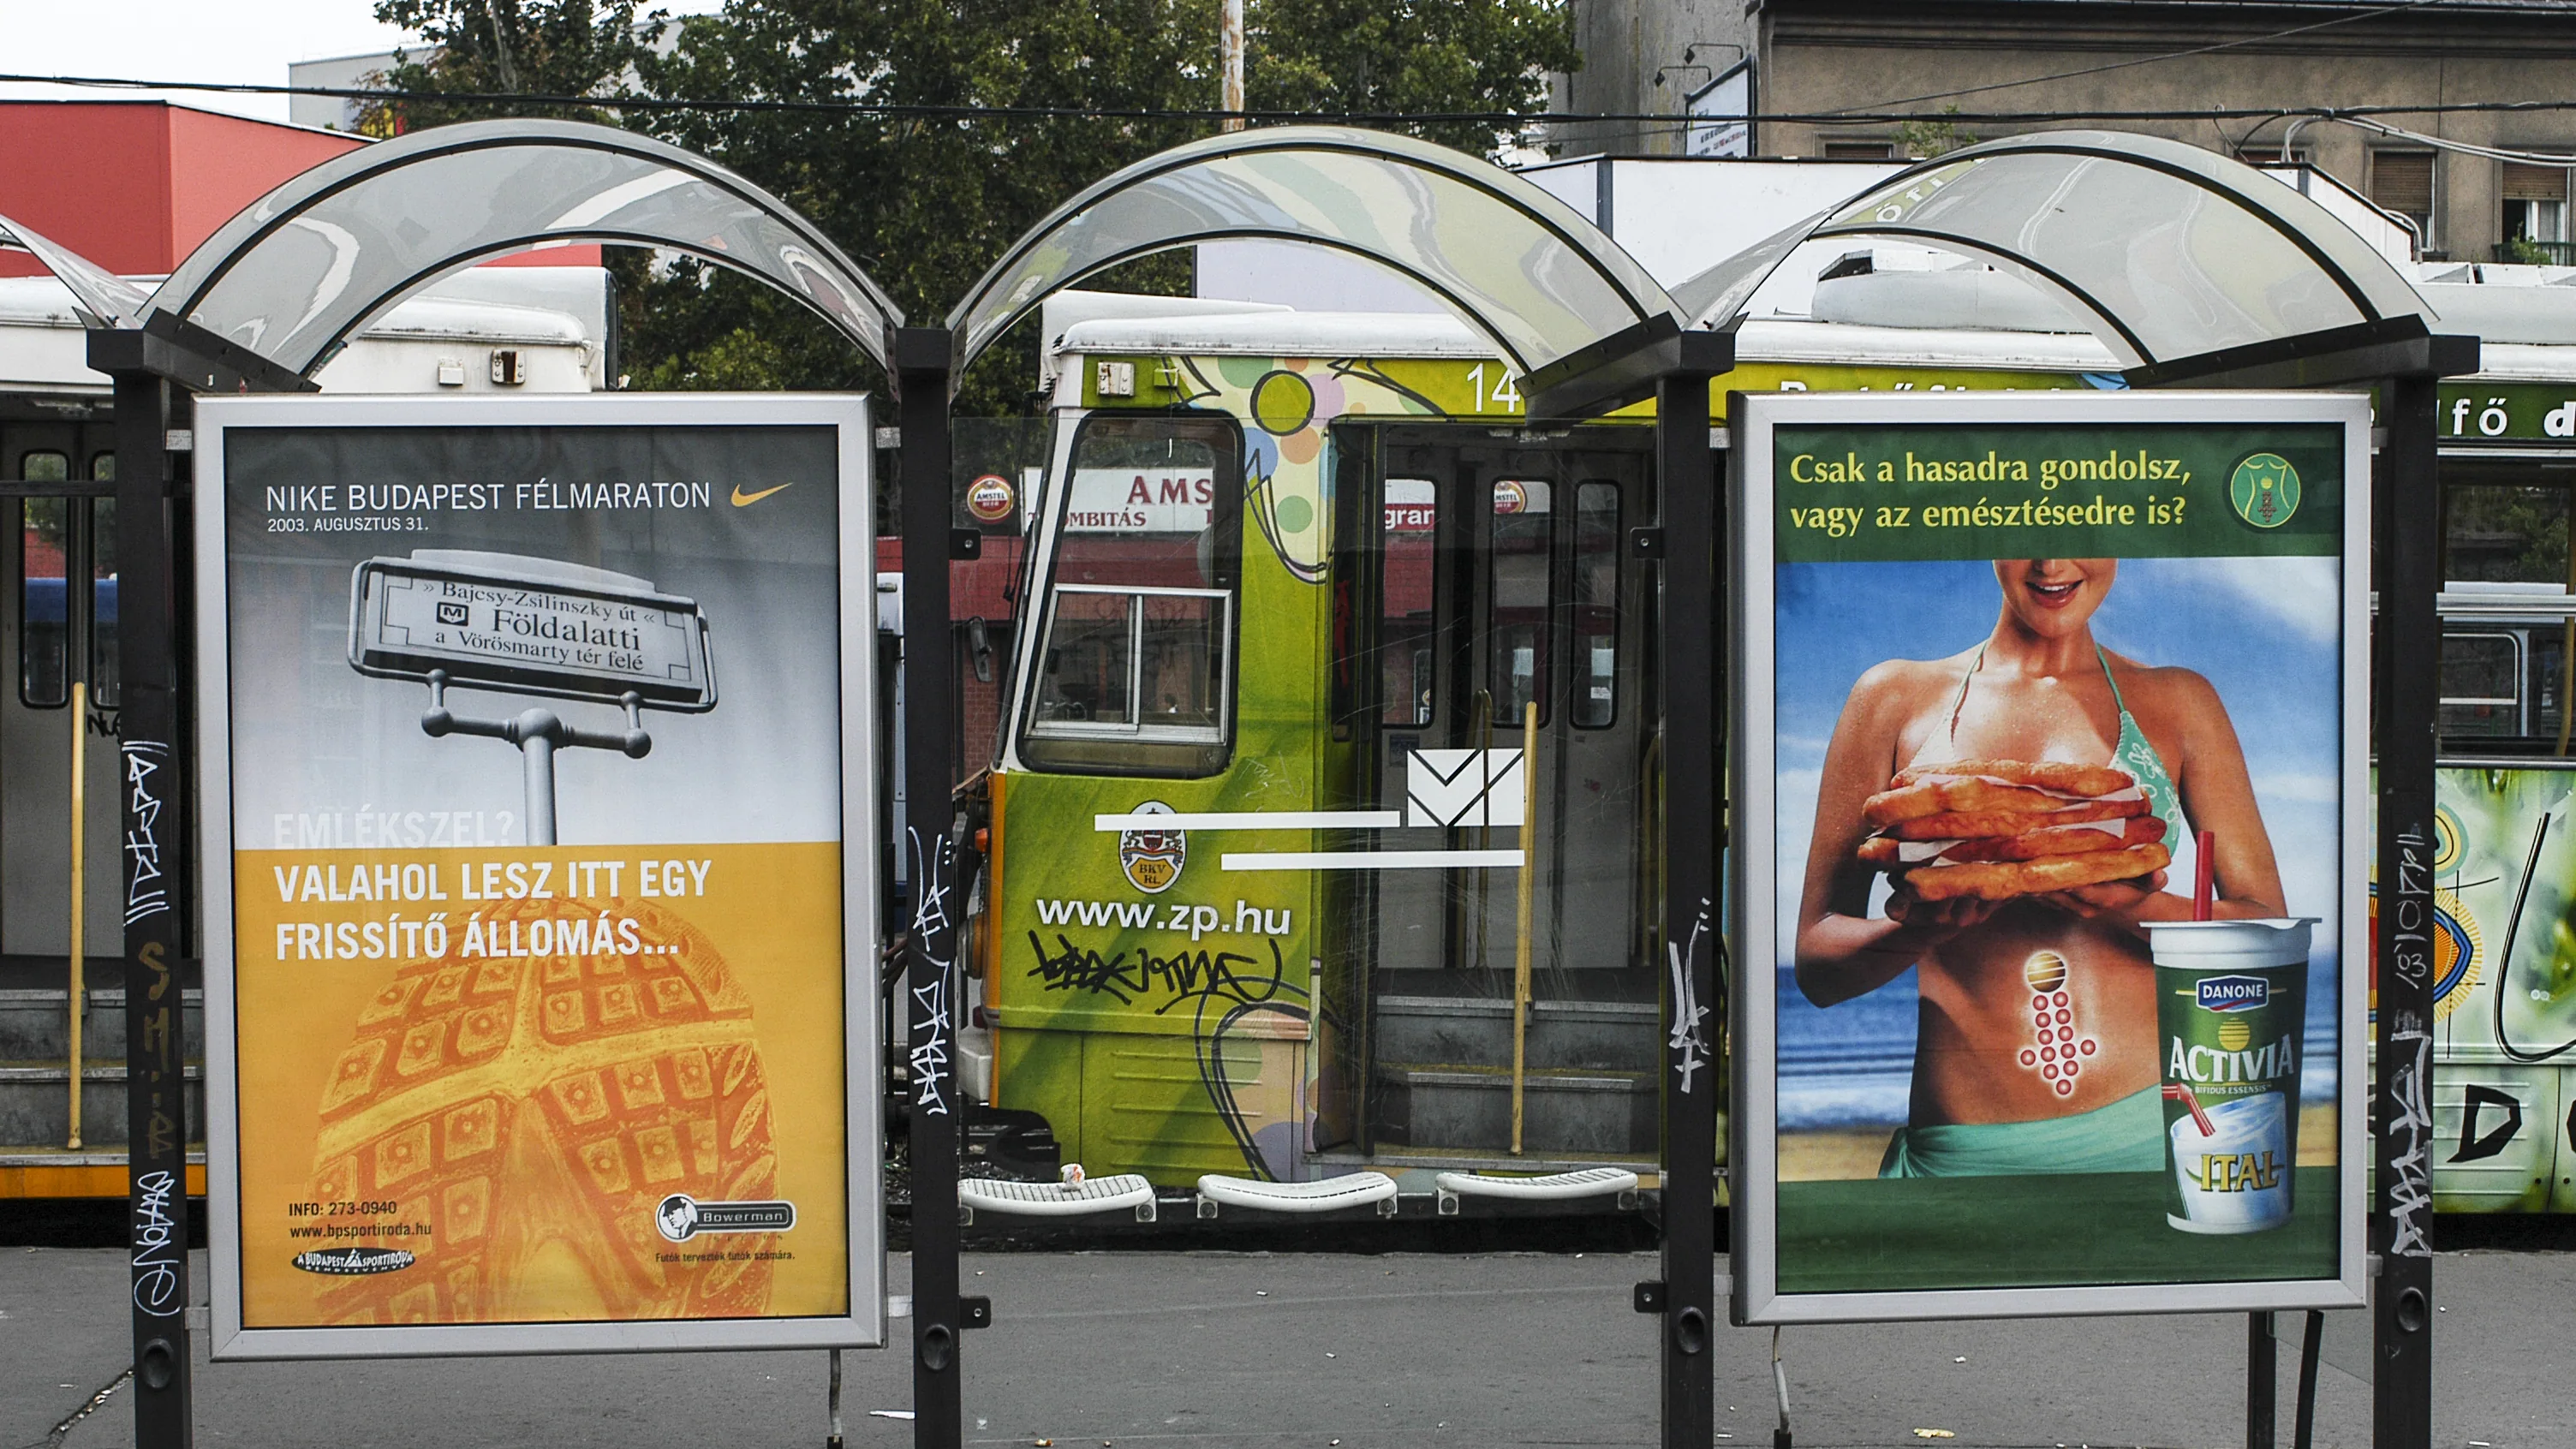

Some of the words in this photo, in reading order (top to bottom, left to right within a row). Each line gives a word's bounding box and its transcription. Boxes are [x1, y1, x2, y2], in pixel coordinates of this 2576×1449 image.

[1467, 362, 1521, 413] 14
[2436, 397, 2508, 436] fő
[1127, 474, 1213, 506] AMS
[1790, 451, 1866, 484] Csak
[1876, 463, 1895, 481] a
[1905, 450, 2030, 482] hasadra
[2040, 449, 2192, 492] gondolsz,
[266, 485, 337, 512] NIKE
[348, 483, 504, 512] BUDAPEST
[516, 476, 711, 510] FÉLMARATON
[267, 517, 309, 534] 2003.
[313, 516, 402, 532] AUGUSZTUS
[405, 516, 429, 531] 31.
[1790, 506, 1864, 539] vagy
[1875, 507, 1911, 528] az
[1922, 494, 2136, 529] emésztésedre
[2147, 495, 2186, 526] is?
[441, 581, 613, 622] Bajcsy-Zsilinszky
[619, 605, 637, 623] út
[434, 632, 446, 644] a
[458, 630, 571, 665] Vörösmarty
[575, 647, 603, 665] tér
[607, 653, 644, 671] felé
[492, 608, 641, 652] Földalatti
[273, 803, 515, 850] EMLÉKSZEL?
[273, 862, 448, 903] VALAHOL
[462, 861, 553, 900] LESZ
[568, 861, 625, 898] ITT
[640, 859, 713, 897] EGY
[1139, 863, 1167, 874] BKV
[276, 912, 449, 960] FRISSÍTŐ
[461, 909, 679, 958] ÁLLOMÁS...
[1036, 897, 1291, 942] www.zp.hu
[2203, 984, 2263, 999] DANONE
[2168, 1033, 2295, 1083] ACTIVIA
[2195, 1085, 2227, 1095] BIFIDUS
[2199, 1150, 2281, 1193] ITAL
[289, 1202, 324, 1216] INFO:
[328, 1201, 397, 1216] 273-0940
[703, 1212, 784, 1223] Bowerman
[290, 1223, 432, 1240] www.bpsportiroda.hu
[305, 1252, 345, 1267] BUDAPEST
